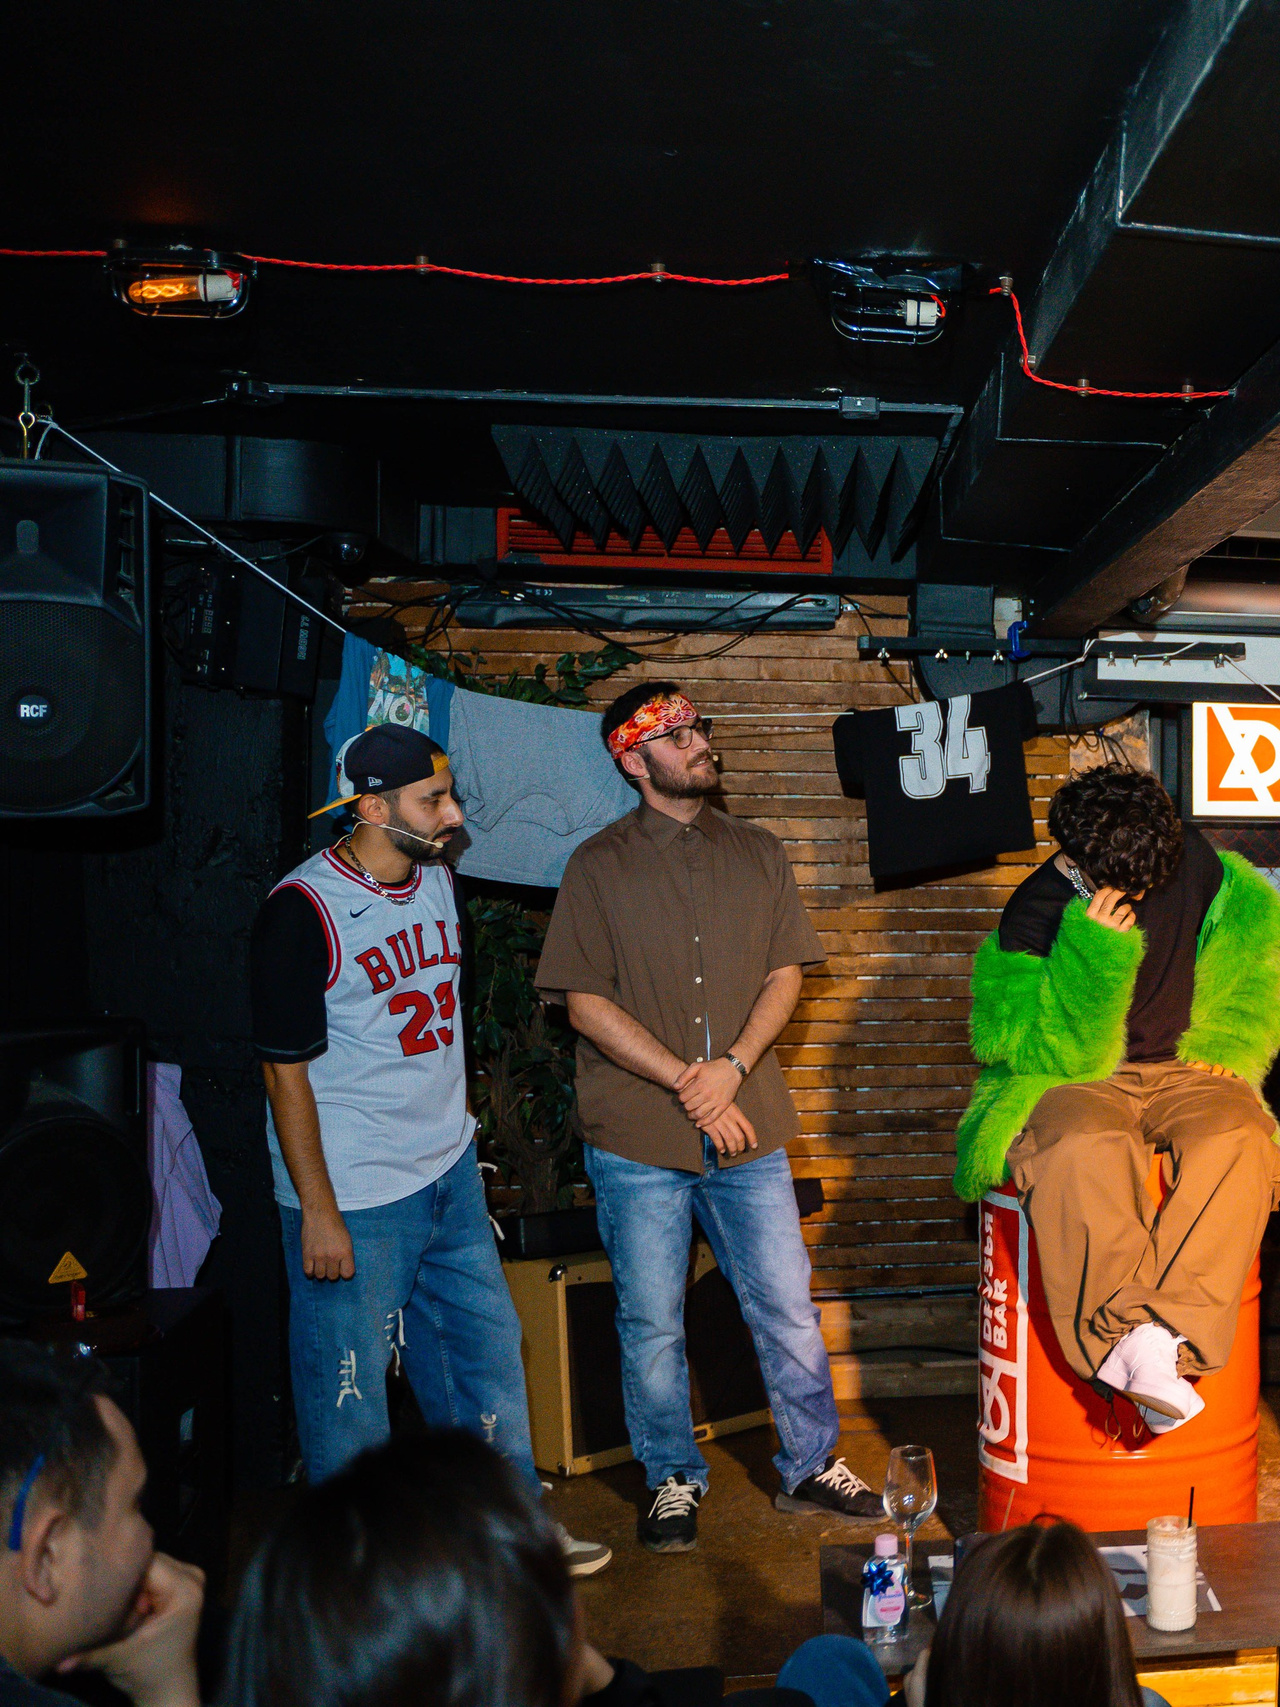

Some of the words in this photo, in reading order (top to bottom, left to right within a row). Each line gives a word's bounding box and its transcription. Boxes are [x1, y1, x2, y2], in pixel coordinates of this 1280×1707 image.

[20, 704, 48, 718] RCF
[895, 694, 991, 799] 34
[388, 981, 456, 1057] 23
[992, 1278, 1008, 1350] BAR
